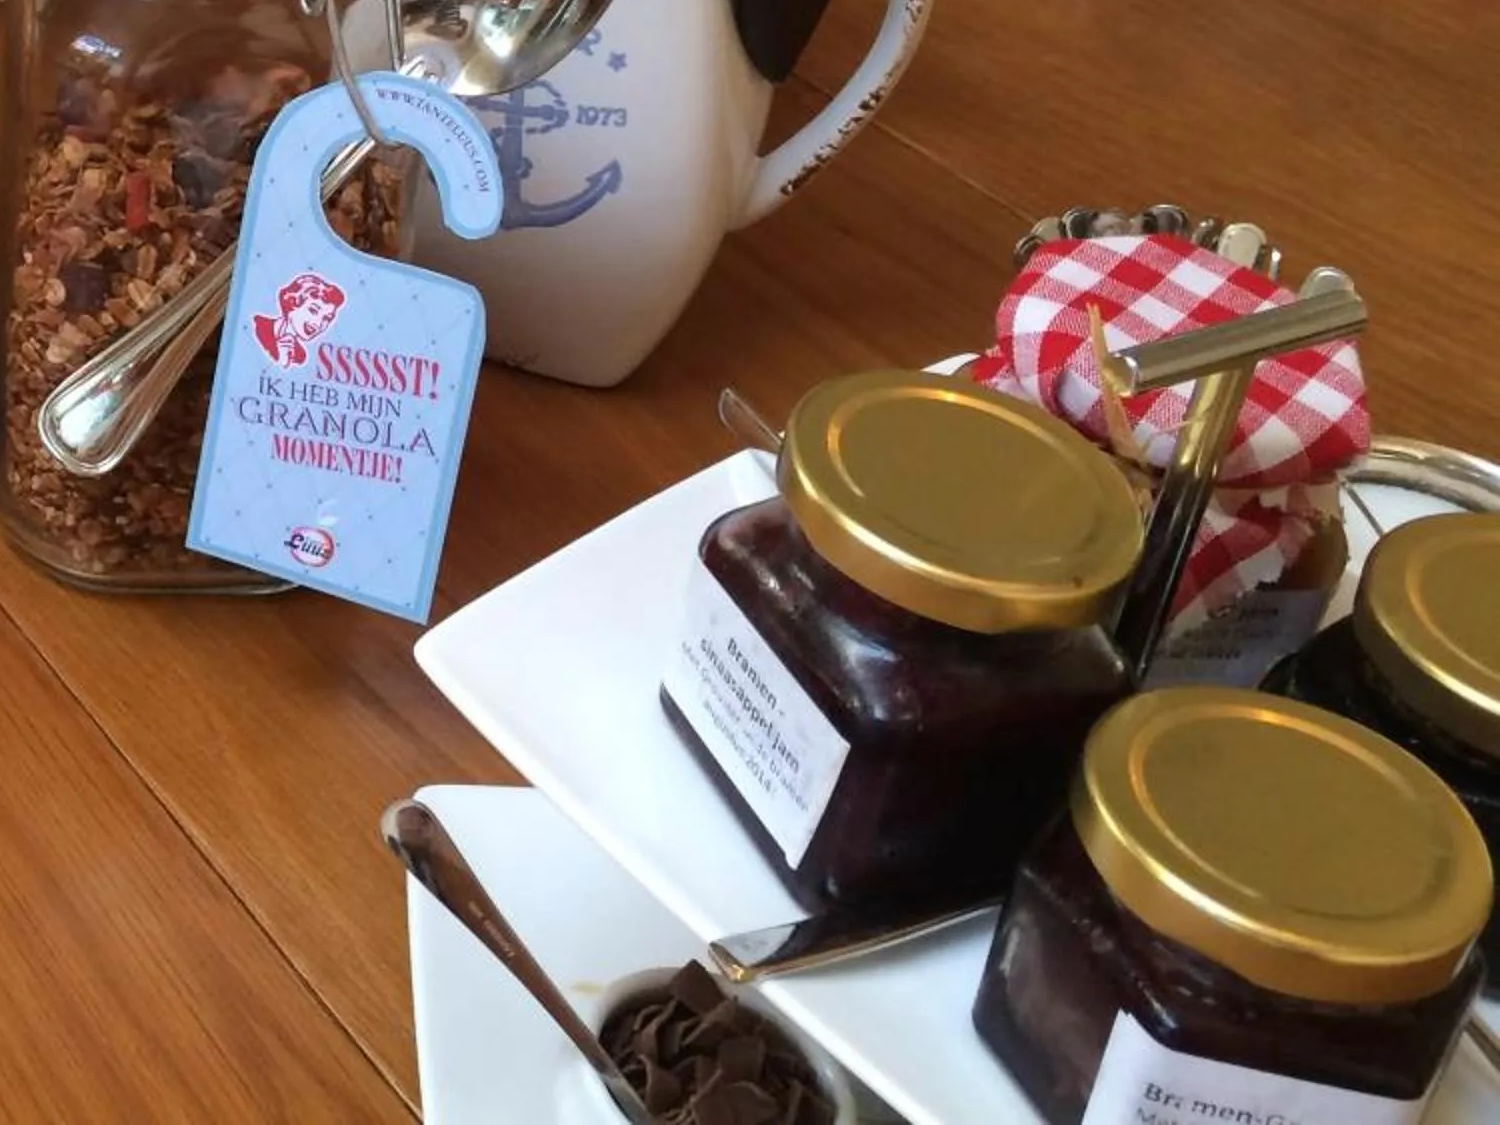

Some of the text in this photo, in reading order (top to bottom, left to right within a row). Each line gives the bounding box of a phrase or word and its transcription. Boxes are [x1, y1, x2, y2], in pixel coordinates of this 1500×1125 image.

[576, 104, 628, 127] 1973
[316, 342, 441, 400] SSSSST!
[238, 396, 436, 457] GRANOLA
[290, 381, 339, 407] HEB
[345, 392, 402, 418] MIJN
[271, 433, 403, 484] MOMENTJE!
[726, 637, 778, 711] Bramen
